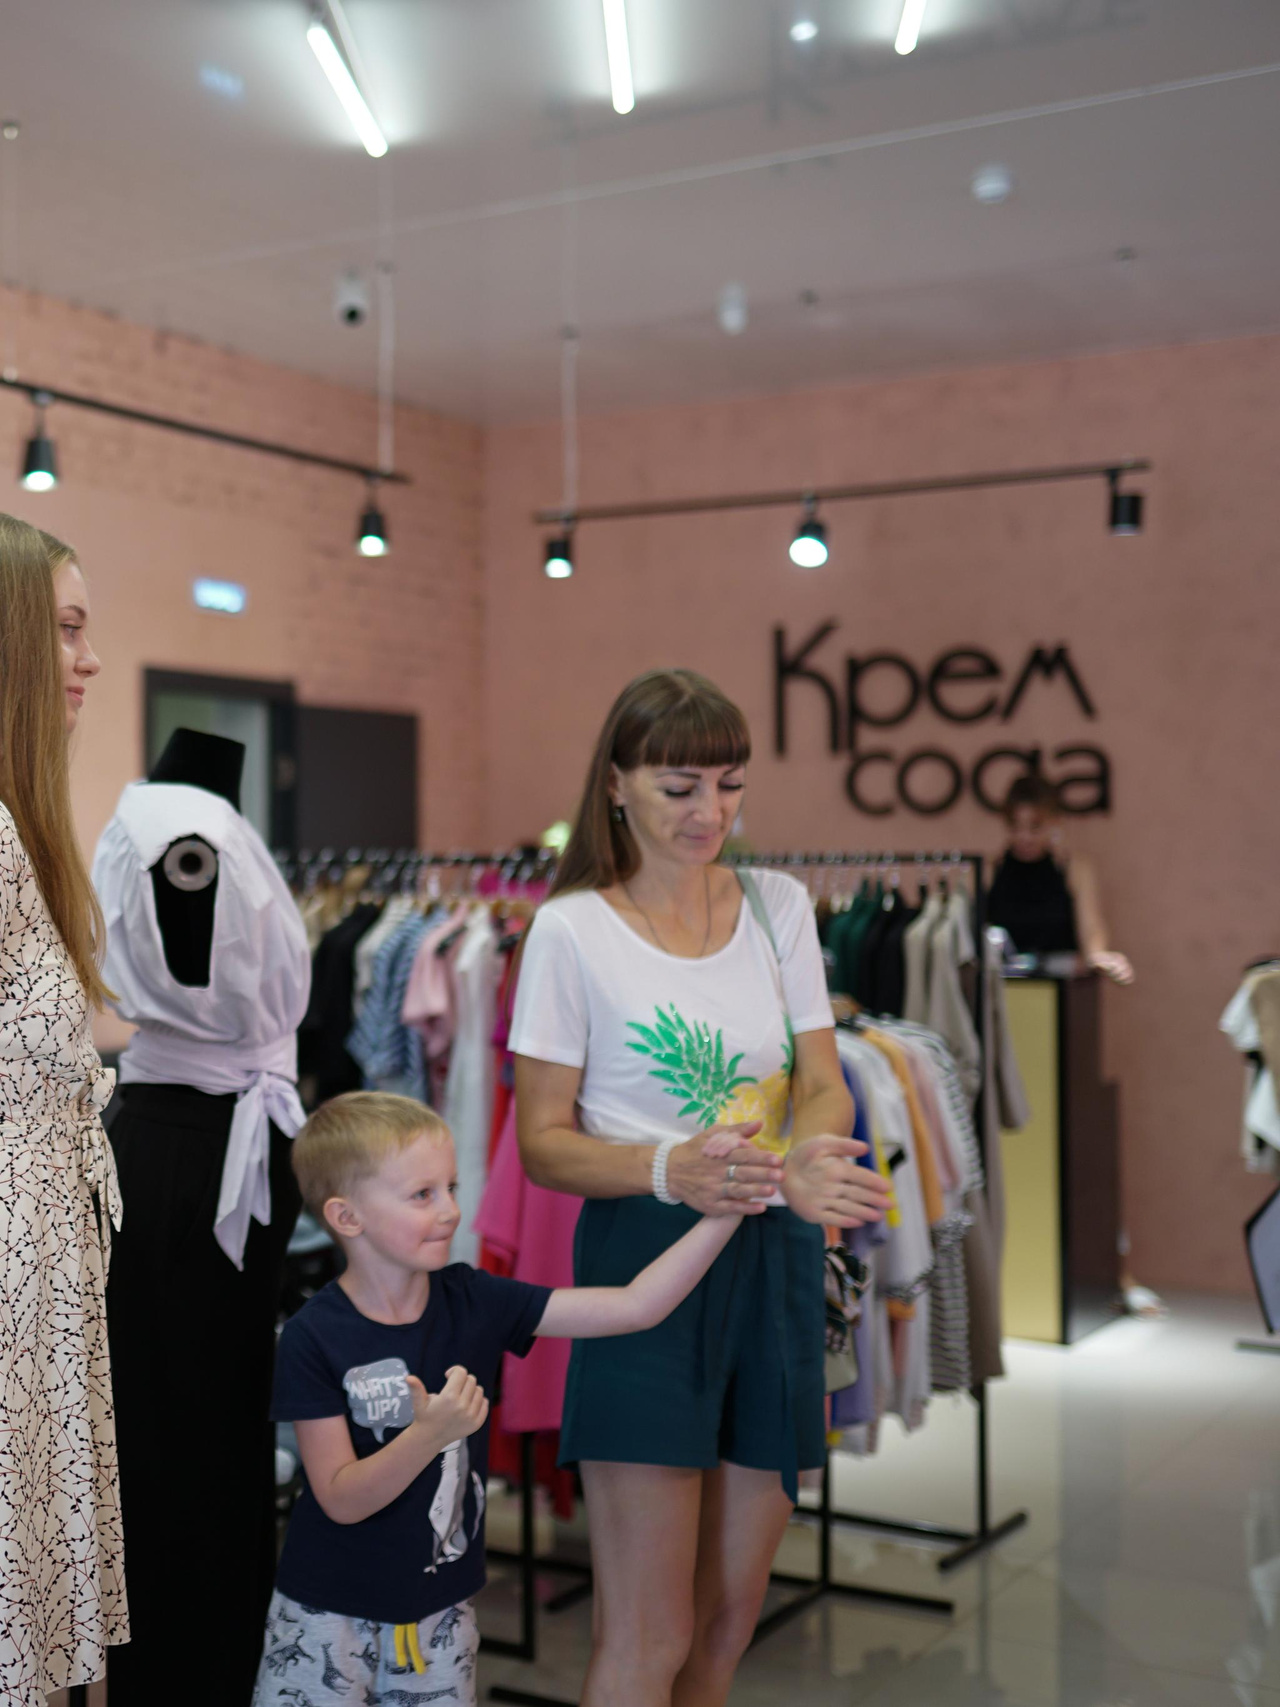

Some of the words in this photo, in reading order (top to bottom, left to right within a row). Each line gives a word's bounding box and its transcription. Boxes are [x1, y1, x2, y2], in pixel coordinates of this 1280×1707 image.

[773, 617, 1095, 757] Крем
[346, 1376, 409, 1399] WHAT'S
[366, 1398, 401, 1421] UP?
